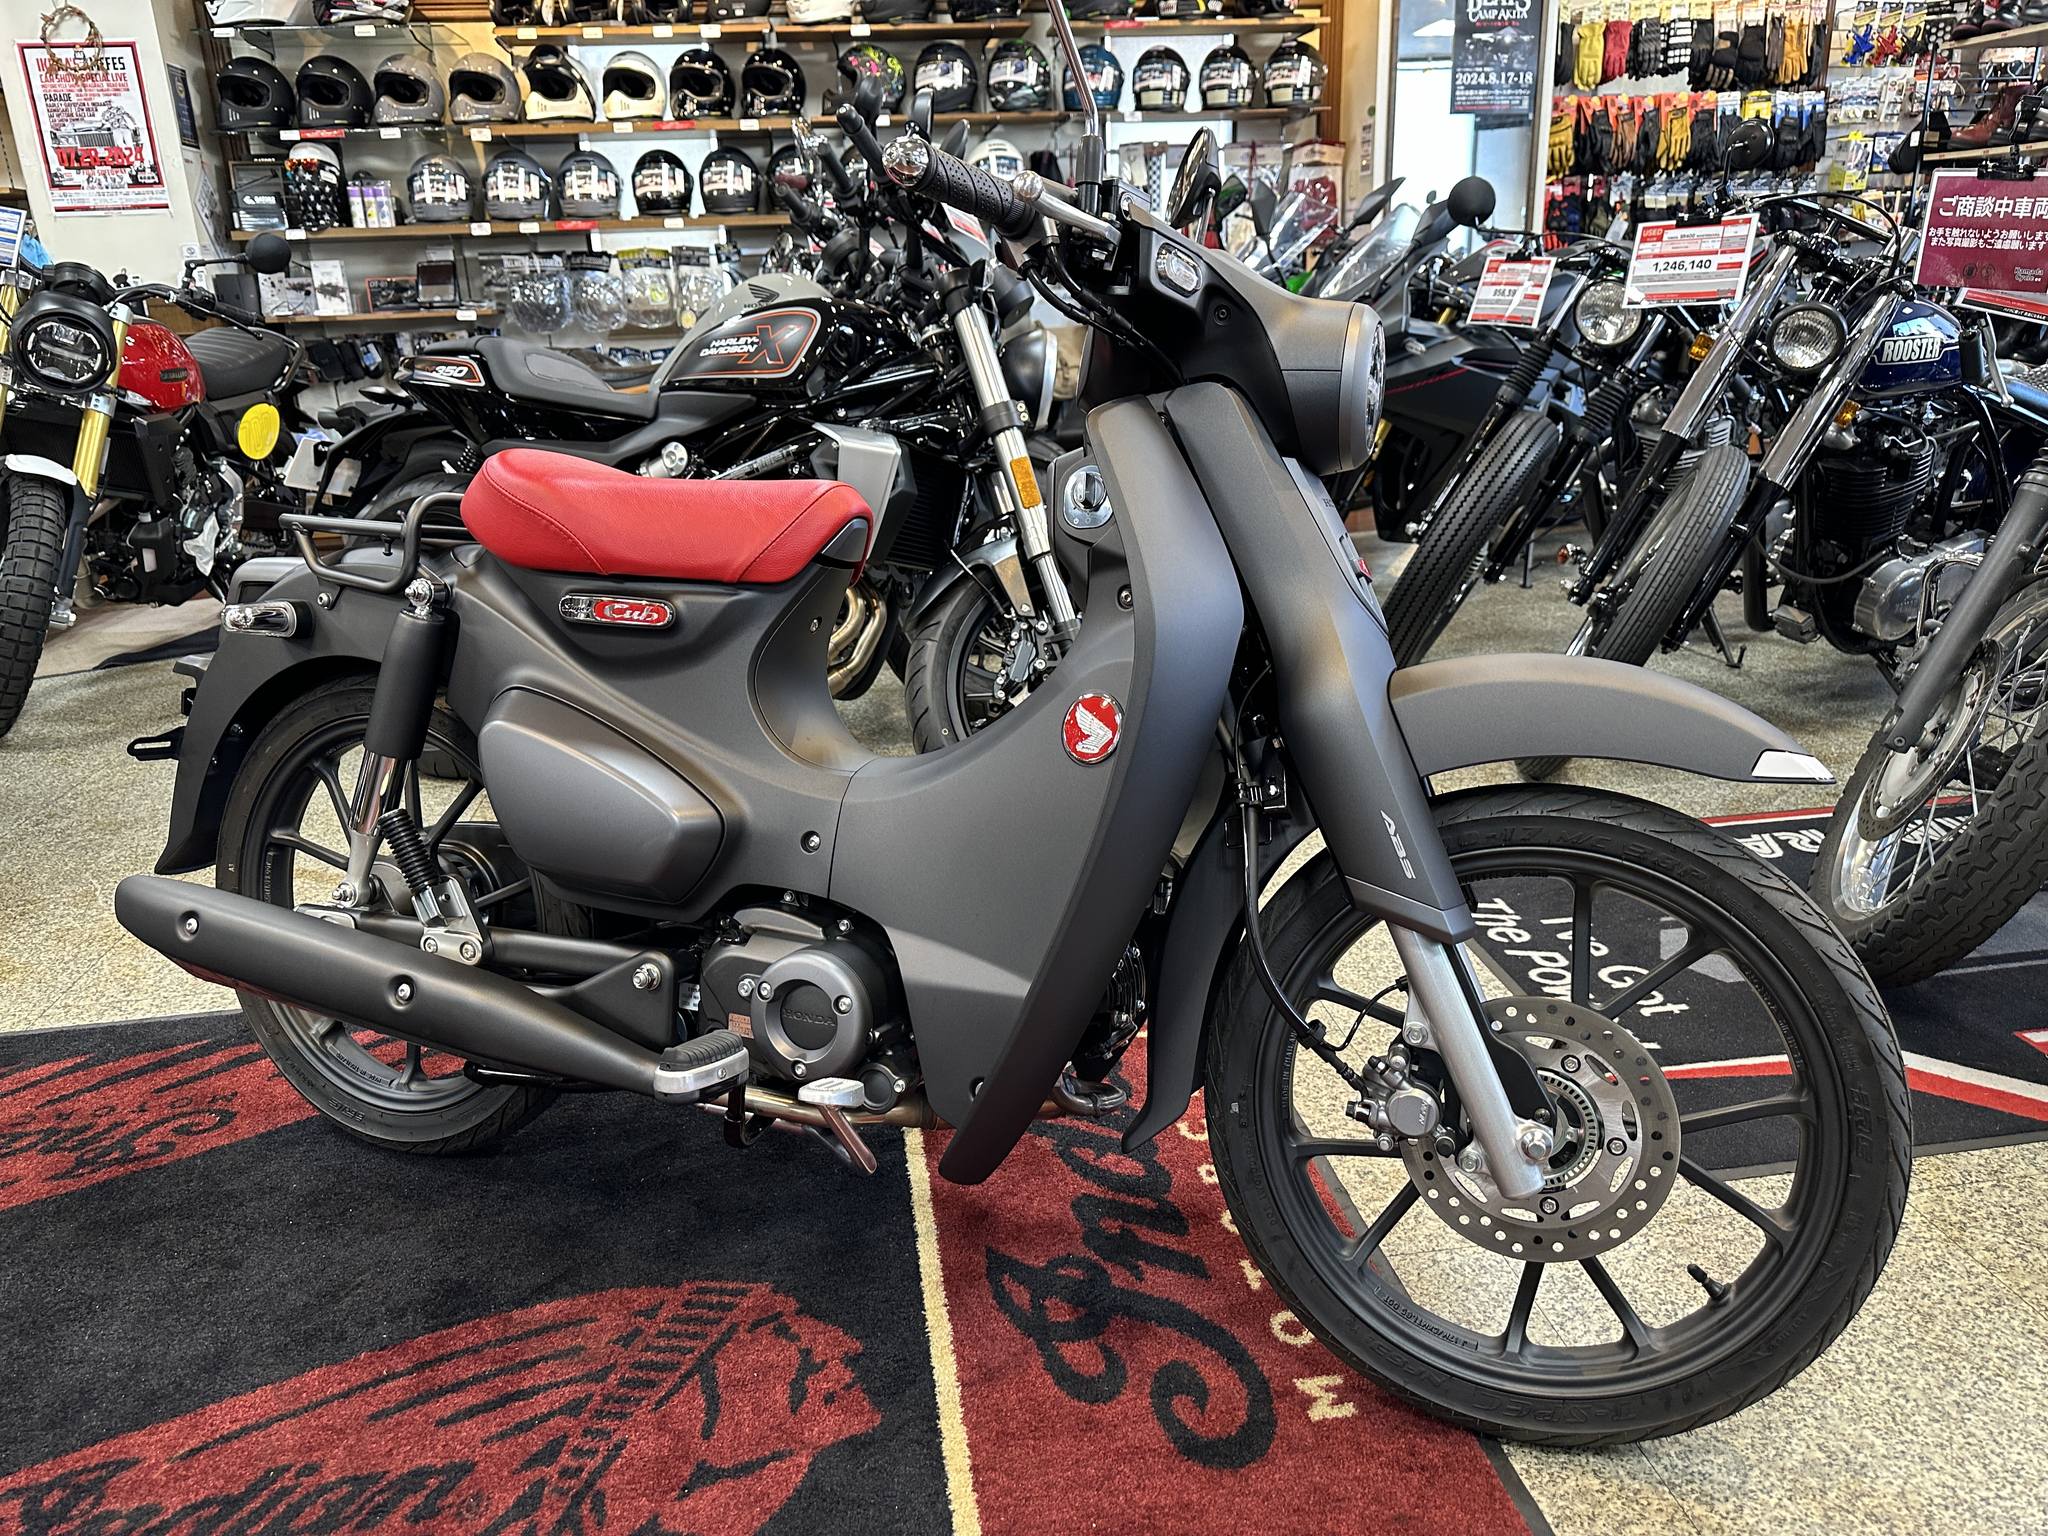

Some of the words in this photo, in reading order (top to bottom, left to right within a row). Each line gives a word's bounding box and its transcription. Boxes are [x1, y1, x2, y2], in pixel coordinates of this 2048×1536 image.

[111, 72, 128, 82] LIVE
[43, 93, 73, 102] PARADE
[1939, 195, 2048, 219] ご商談中車両
[1642, 228, 1663, 238] USED
[1652, 258, 1712, 273] 1,246,140
[700, 344, 758, 357] DAVIDSON
[1881, 337, 1940, 362] ROOSTER
[433, 365, 468, 378] 350
[603, 602, 658, 619] Cub
[1380, 809, 1416, 879] ABS
[782, 1007, 836, 1028] HONDA
